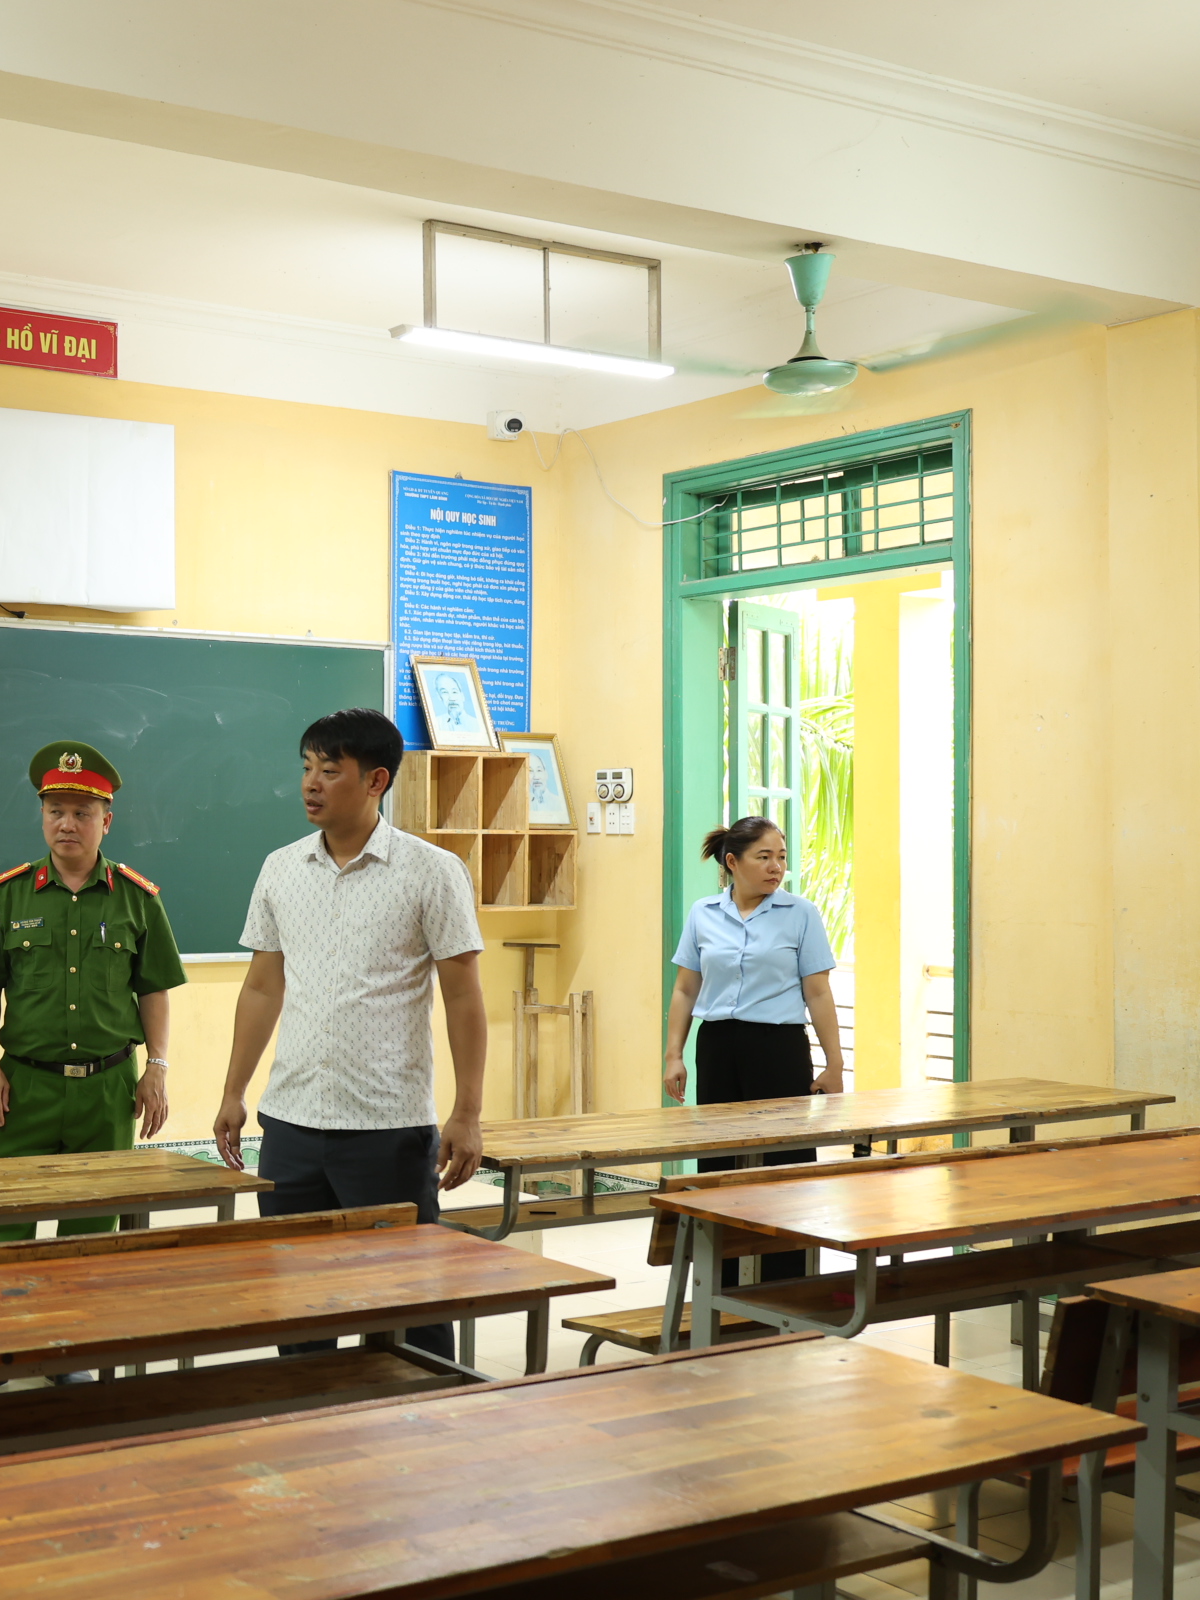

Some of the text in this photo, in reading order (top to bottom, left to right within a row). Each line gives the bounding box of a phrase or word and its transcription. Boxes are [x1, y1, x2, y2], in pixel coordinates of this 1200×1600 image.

[6, 323, 33, 352] HỒ
[39, 329, 59, 354] VĨ
[64, 335, 97, 363] ĐẠI
[430, 508, 497, 526] NỘI QUY HỌC SINH
